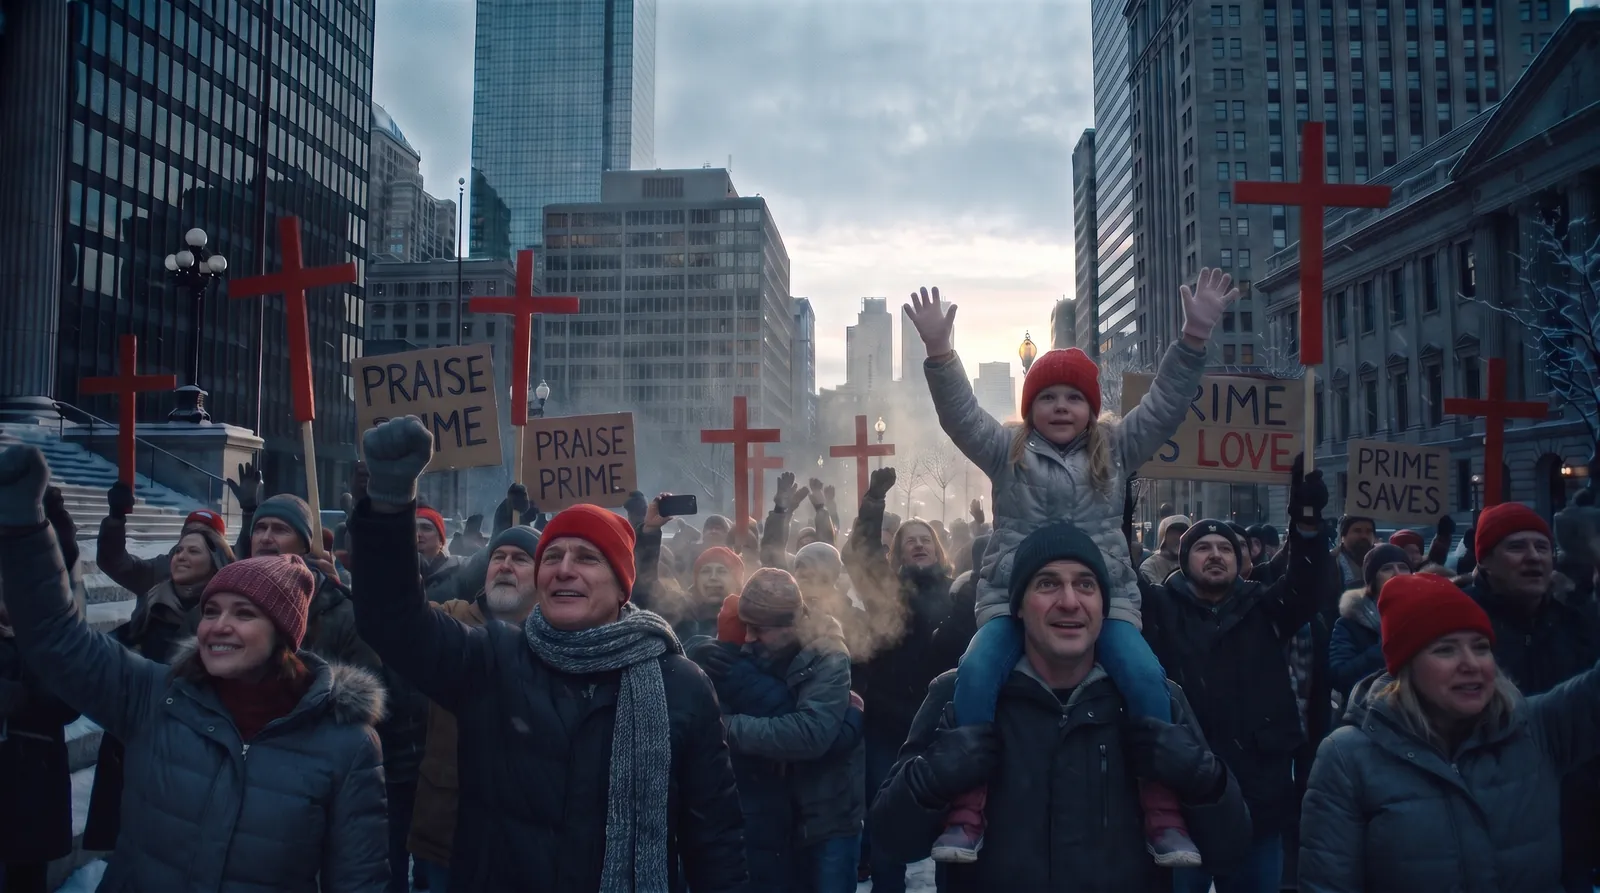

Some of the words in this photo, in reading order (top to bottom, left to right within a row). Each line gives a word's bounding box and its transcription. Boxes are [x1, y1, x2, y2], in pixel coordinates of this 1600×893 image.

[362, 354, 487, 407] PRAISE
[1189, 383, 1287, 426] RIME
[535, 425, 627, 461] PRAISE
[1148, 438, 1180, 463] S
[1197, 428, 1294, 472] LOVE
[539, 462, 626, 500] PRIME
[1358, 447, 1440, 480] PRIME
[1356, 480, 1440, 515] SAVES
